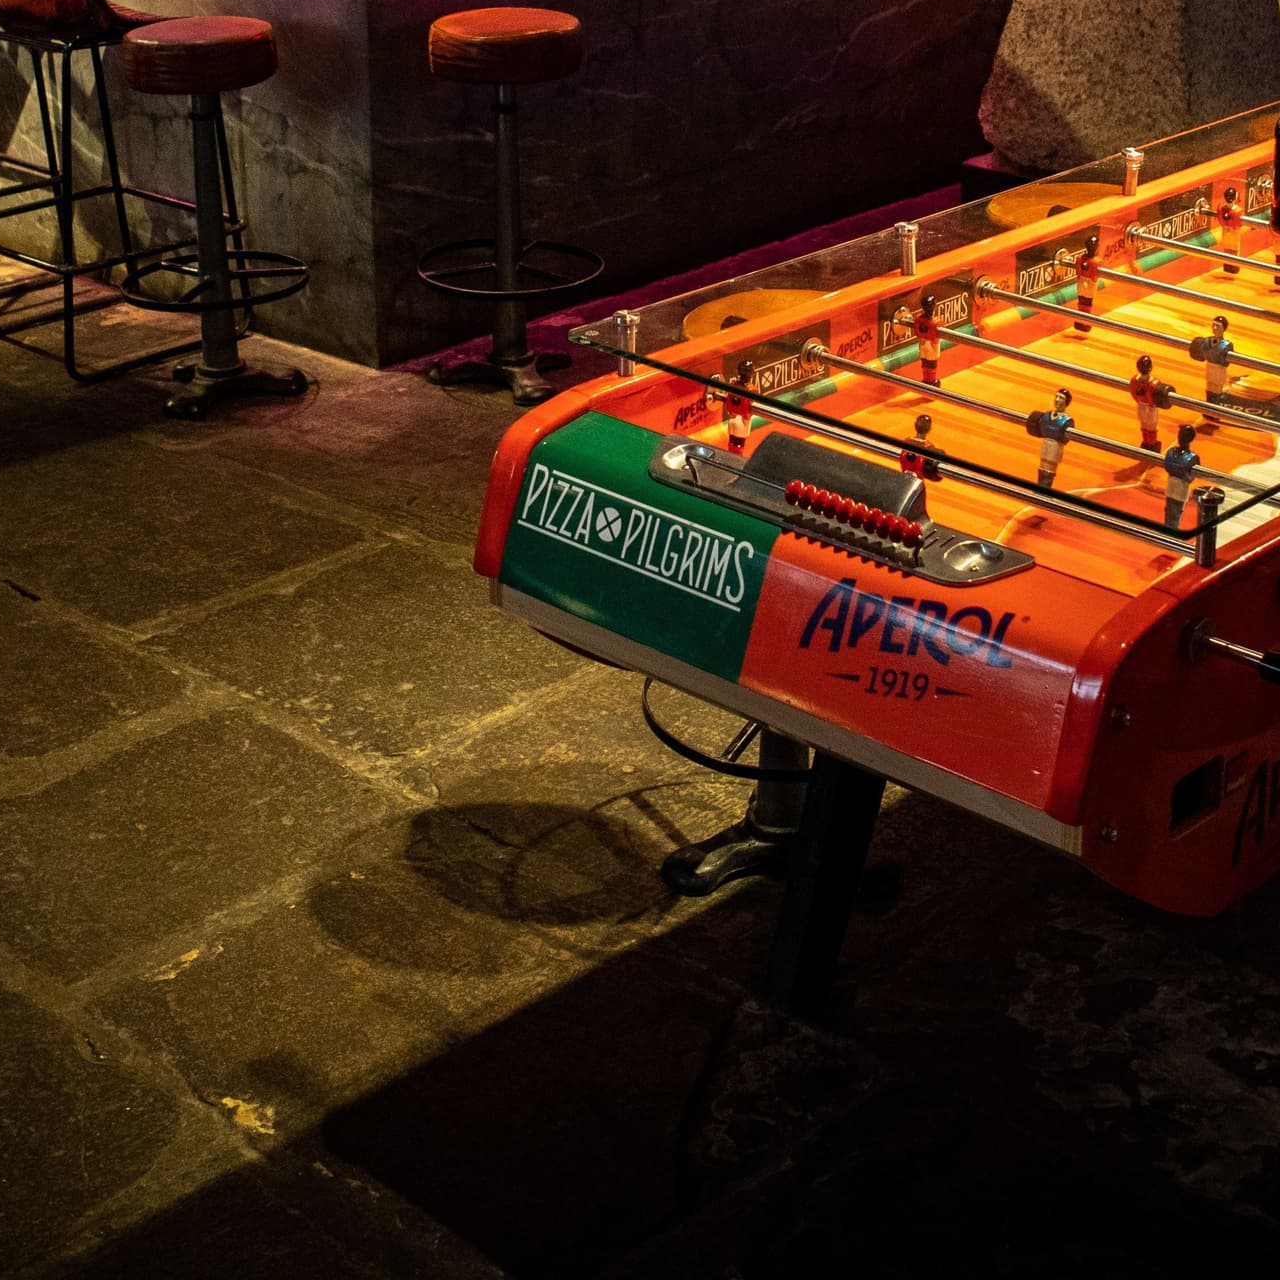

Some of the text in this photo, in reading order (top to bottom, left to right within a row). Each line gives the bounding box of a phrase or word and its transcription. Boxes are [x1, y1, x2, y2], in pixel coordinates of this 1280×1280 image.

[1019, 265, 1045, 295] PIZZA
[837, 326, 874, 358] APEROL
[521, 462, 755, 605] PIZZA PILGRIMS
[797, 577, 1016, 668] APEROL
